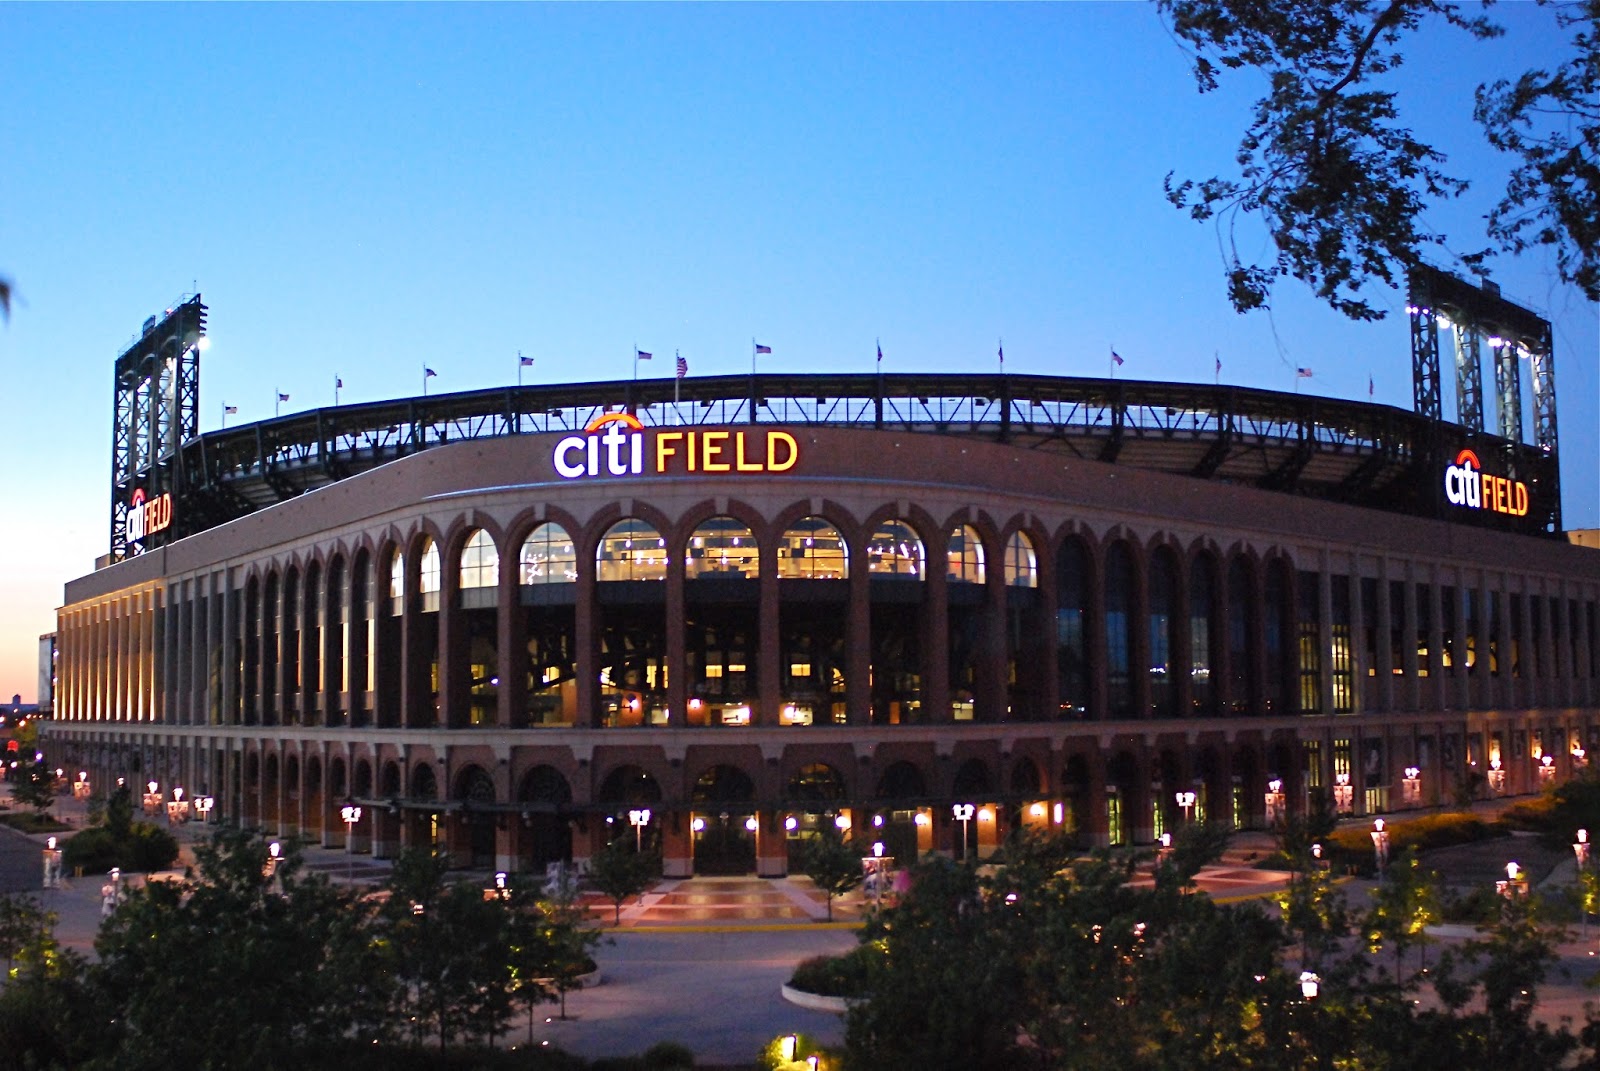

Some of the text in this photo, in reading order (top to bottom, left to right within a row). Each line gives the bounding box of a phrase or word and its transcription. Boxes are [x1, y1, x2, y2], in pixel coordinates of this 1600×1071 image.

[553, 423, 798, 478] citi FIELD
[144, 493, 171, 536] FIELD
[1445, 460, 1529, 516] citi FIELD
